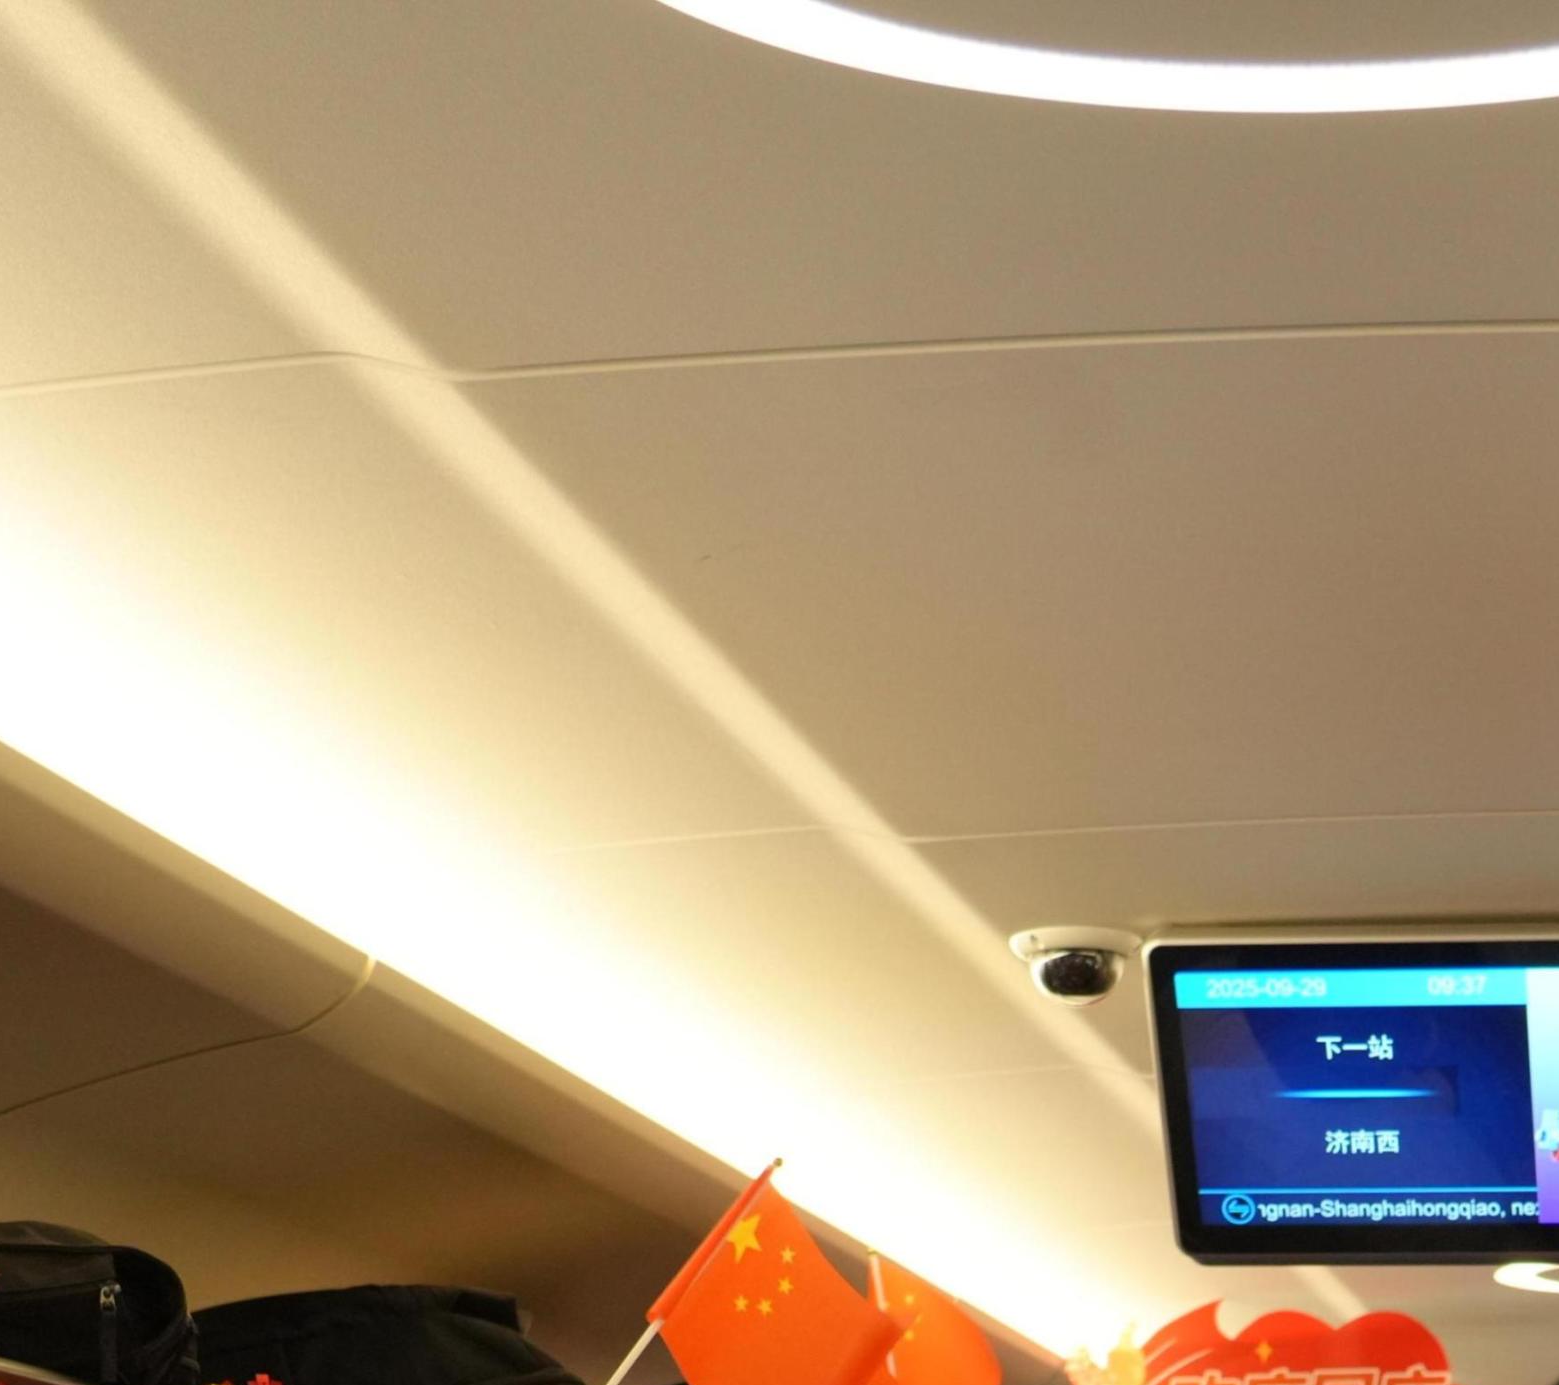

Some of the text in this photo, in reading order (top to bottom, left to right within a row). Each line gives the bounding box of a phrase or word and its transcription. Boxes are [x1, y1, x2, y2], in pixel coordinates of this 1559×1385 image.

[1206, 977, 1328, 999] 2025-09-29
[1426, 974, 1488, 996] 09:37
[1316, 1034, 1394, 1061] 下一站
[1324, 1129, 1401, 1155] 济南西
